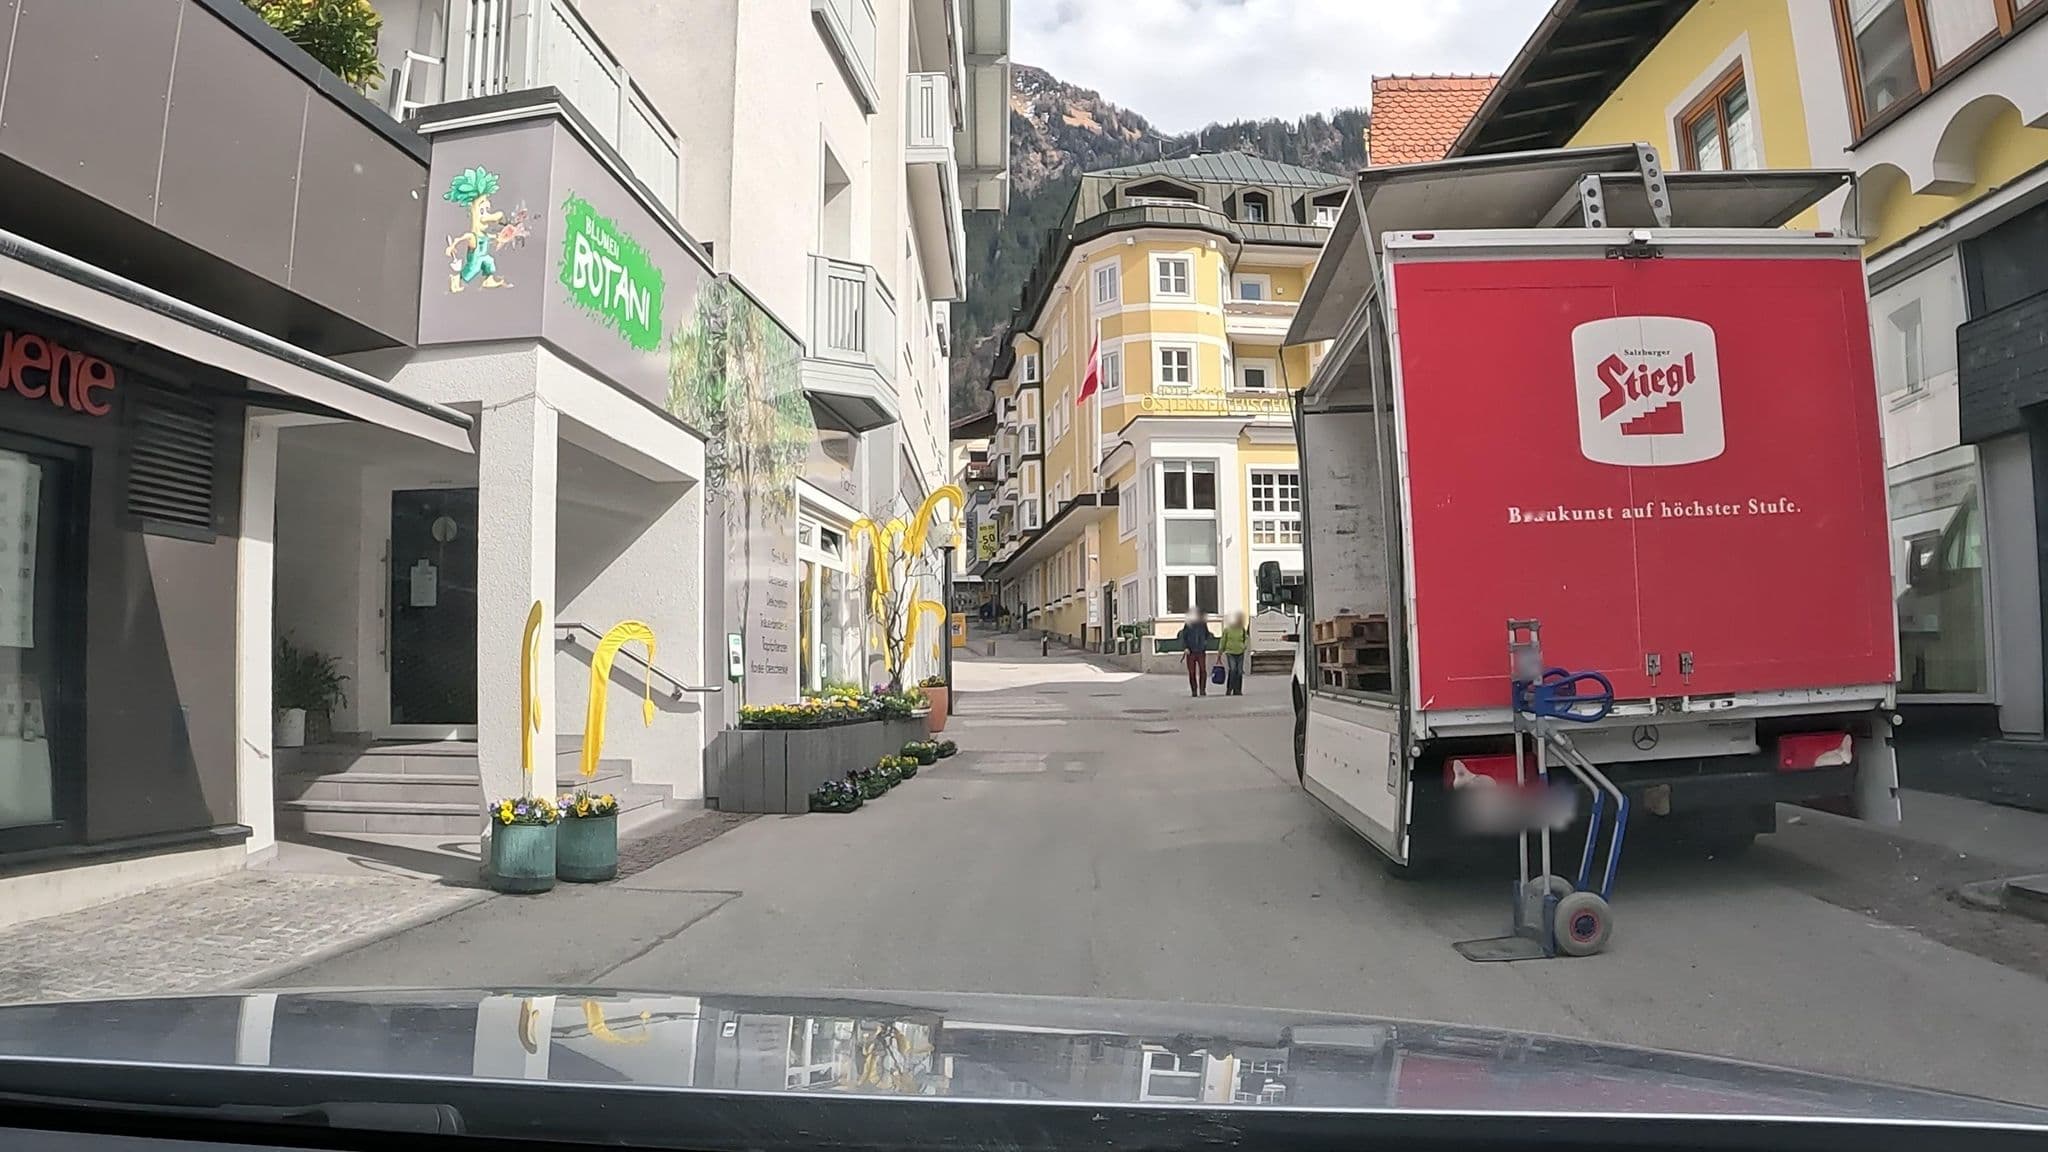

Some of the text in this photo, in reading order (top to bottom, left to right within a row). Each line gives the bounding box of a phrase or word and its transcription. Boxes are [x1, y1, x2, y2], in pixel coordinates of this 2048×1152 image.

[585, 214, 620, 262] BLUMEN
[572, 230, 651, 333] BOTANI
[1624, 348, 1671, 357] Salzburger
[1597, 351, 1697, 422] Stiegl
[1621, 501, 1655, 520] auf
[1660, 500, 1742, 518] höchster
[1748, 496, 1802, 515] Stufe.
[979, 533, 996, 545] -50
